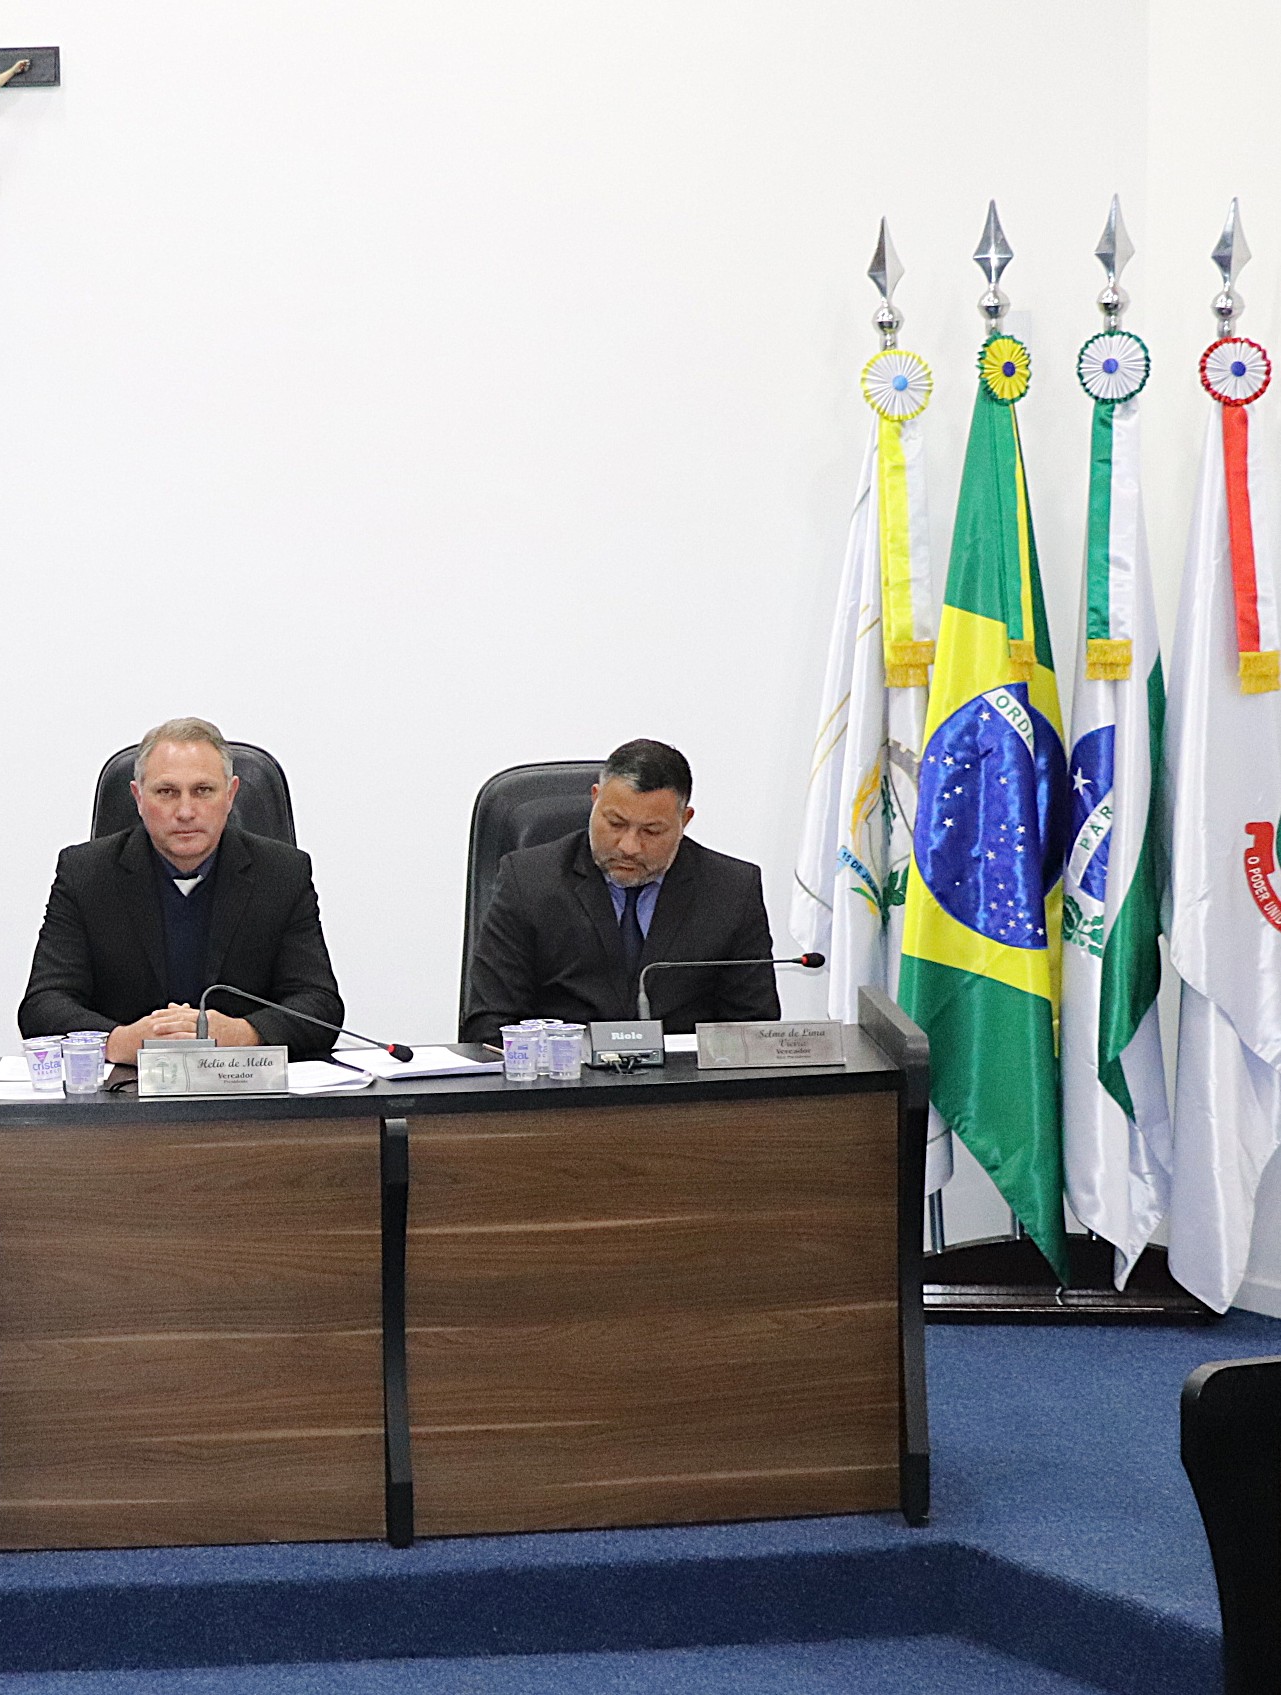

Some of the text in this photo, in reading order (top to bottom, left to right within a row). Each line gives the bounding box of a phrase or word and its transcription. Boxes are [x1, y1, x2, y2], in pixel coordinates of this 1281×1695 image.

[1247, 856, 1260, 865] O
[850, 860, 863, 874] DE
[1248, 867, 1271, 902] PODER
[610, 1031, 643, 1040] Riole
[228, 1058, 240, 1068] de
[242, 1057, 274, 1067] Mello
